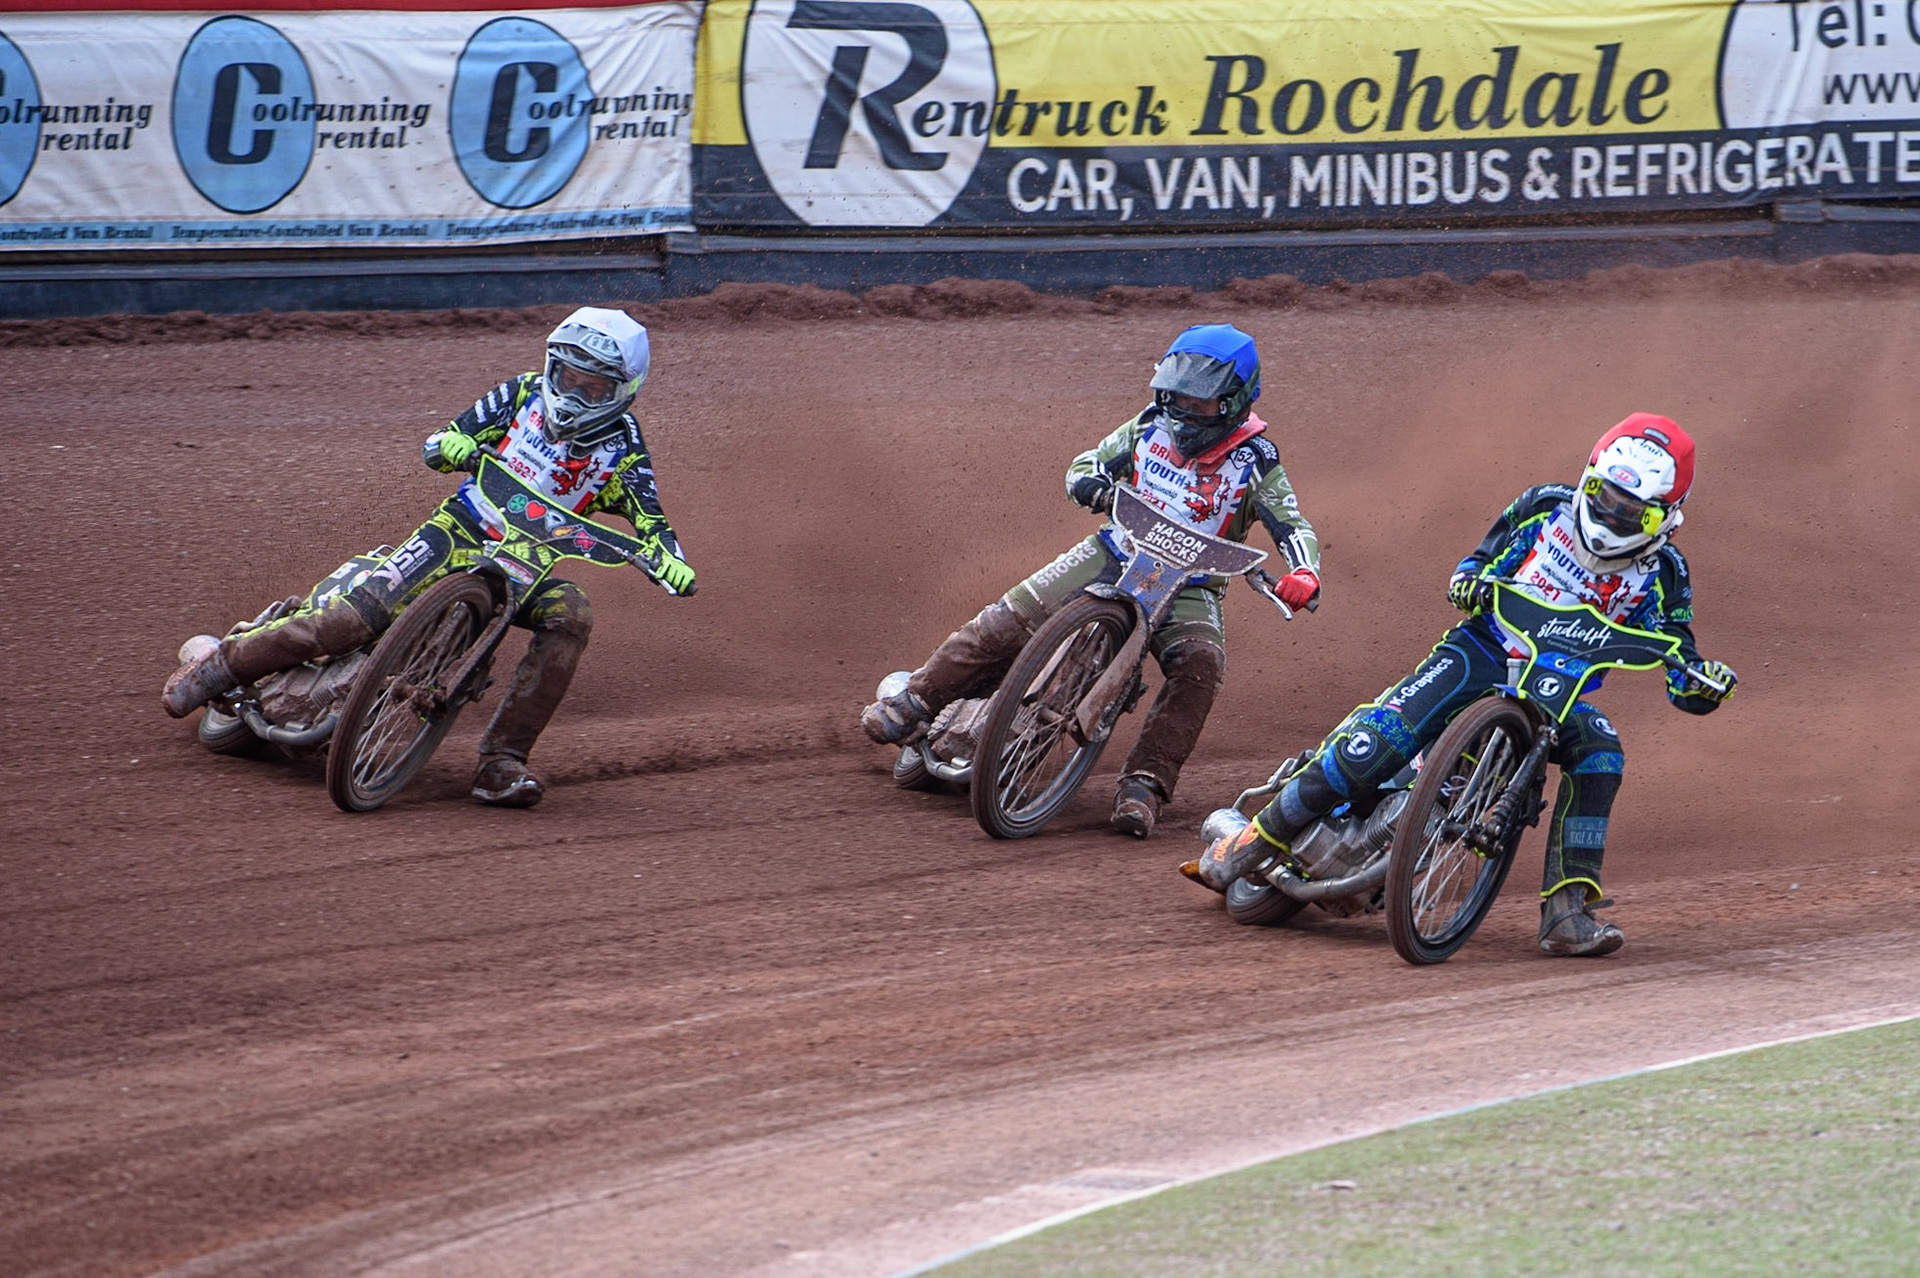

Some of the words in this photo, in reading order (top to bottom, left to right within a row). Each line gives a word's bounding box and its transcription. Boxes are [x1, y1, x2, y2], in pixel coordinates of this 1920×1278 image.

[787, 0, 1170, 171] Rentruck
[1191, 43, 1671, 136] Rochdale
[0, 97, 153, 129] olrunning
[595, 115, 680, 141] rental
[42, 127, 134, 151] rental
[318, 126, 408, 149] rental
[1008, 156, 1134, 222] CAR,
[1145, 157, 1275, 219] VAN,
[1289, 148, 1512, 208] MINIBUS
[1521, 147, 1559, 200] &
[521, 427, 557, 460] YOUTH
[1233, 450, 1254, 464] 152
[507, 457, 537, 482] 2021
[1144, 457, 1187, 487] YOUTH
[1145, 532, 1198, 563] SHOCKS
[1151, 522, 1207, 553] HAGON
[1036, 543, 1098, 587] SHOCKS
[1547, 541, 1585, 580] YOUTH
[1530, 571, 1561, 601] 2021
[1537, 617, 1613, 648] studio44
[1389, 658, 1453, 706] K-Graphics
